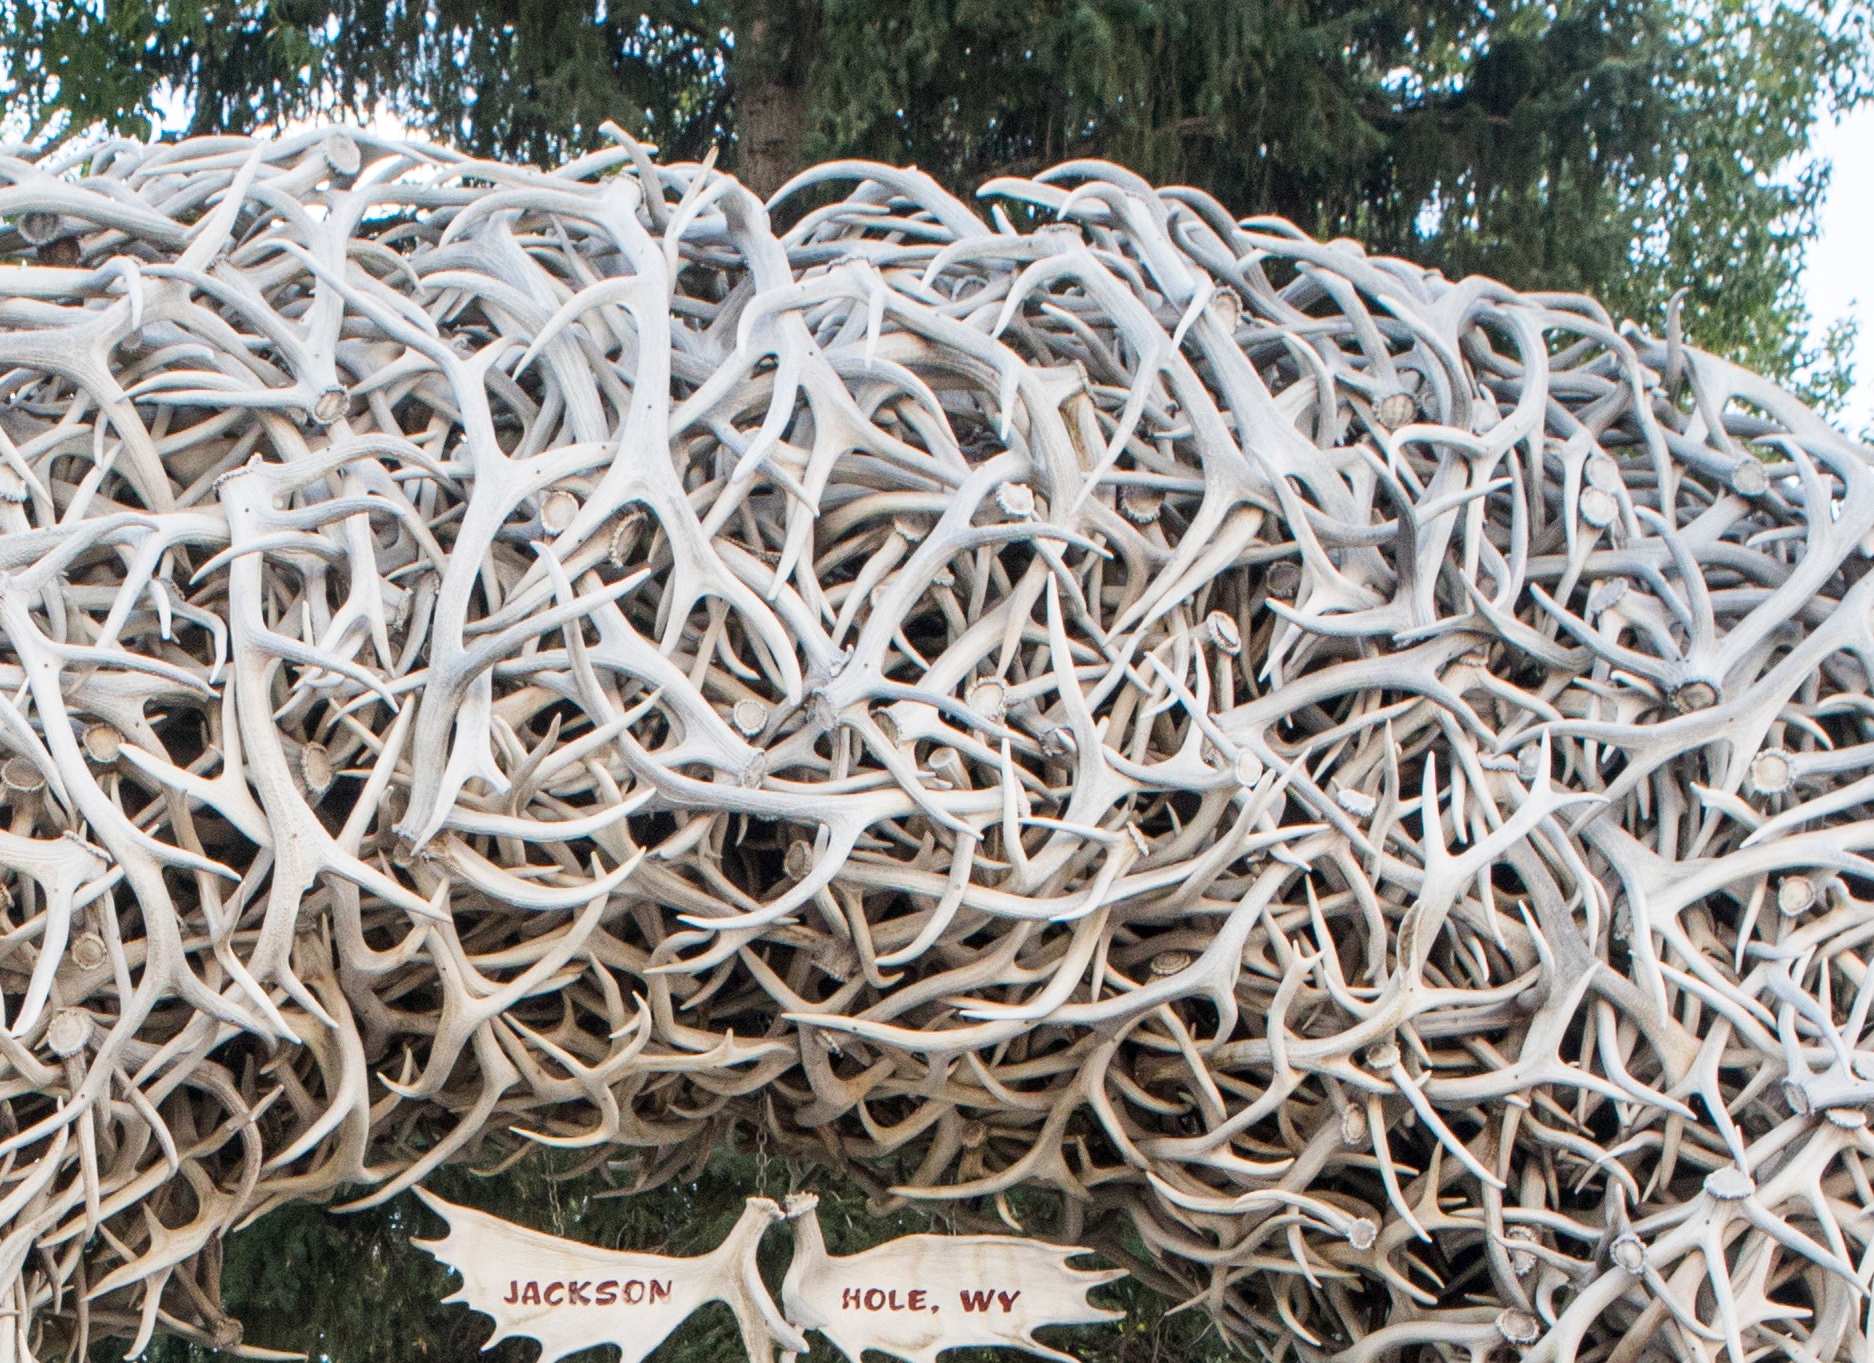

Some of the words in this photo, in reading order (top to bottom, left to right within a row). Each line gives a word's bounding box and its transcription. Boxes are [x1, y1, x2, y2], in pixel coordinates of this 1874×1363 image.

[503, 1279, 673, 1306] JACKSON
[842, 1288, 940, 1314] HOLE,
[959, 1289, 1021, 1313] WY
